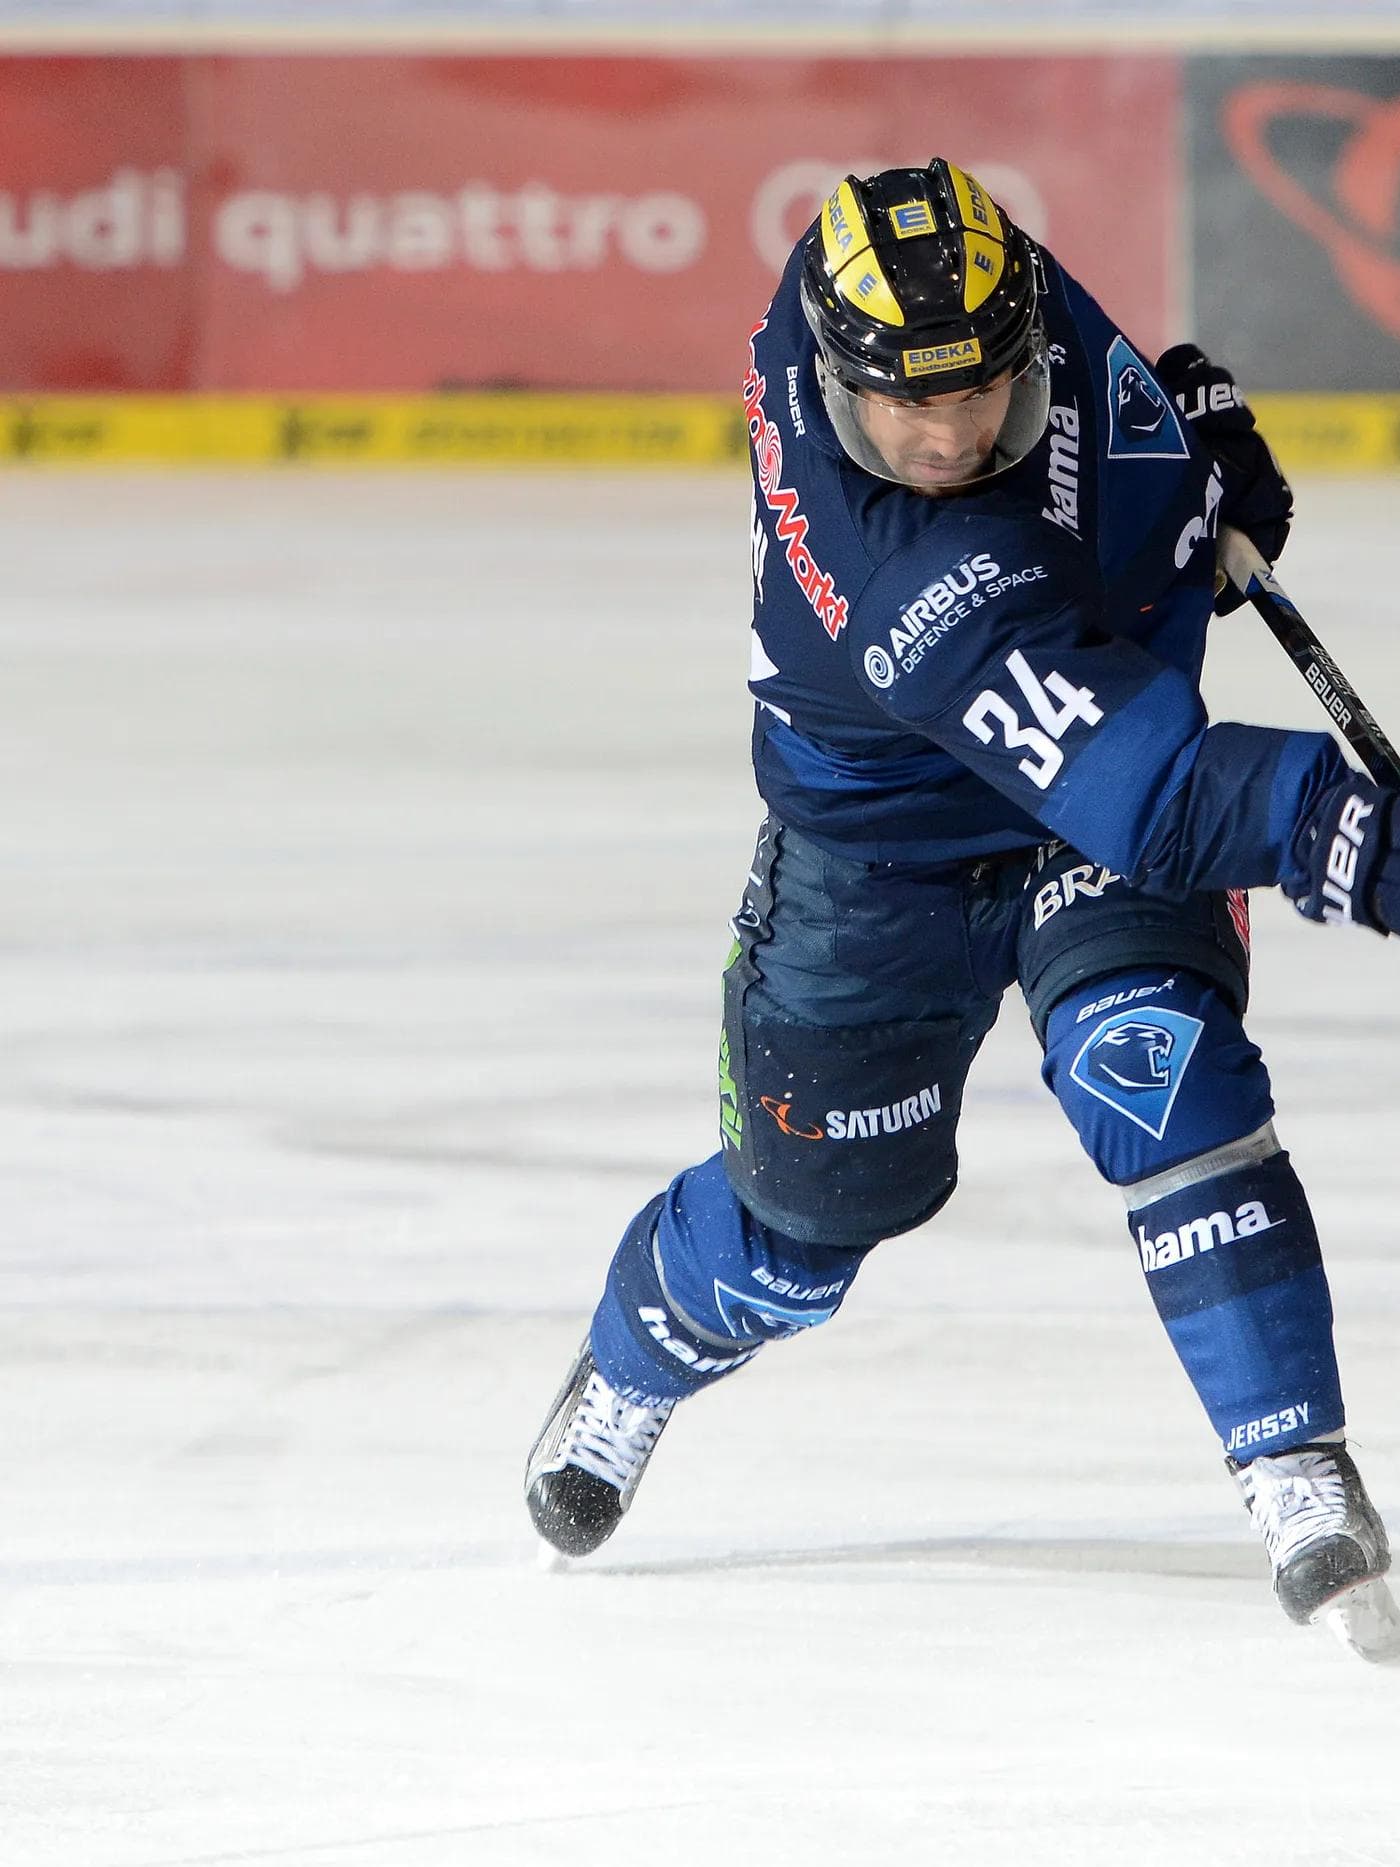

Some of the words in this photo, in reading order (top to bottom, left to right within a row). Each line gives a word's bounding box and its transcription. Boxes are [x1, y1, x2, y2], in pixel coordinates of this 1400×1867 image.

[212, 188, 706, 293] quattro
[895, 205, 930, 229] E
[908, 341, 975, 364] EDEKA
[786, 365, 806, 439] BAUER
[1041, 394, 1082, 541] hama
[766, 487, 849, 642] Markt
[889, 552, 1001, 660] AIRBUS
[901, 600, 972, 674] DEFENCE
[971, 592, 987, 608] &
[985, 565, 1049, 599] SPACE
[961, 649, 1104, 790] 34
[1304, 661, 1353, 731] BAUER
[1076, 978, 1176, 1024] BAUER
[825, 1083, 942, 1140] SATURN
[1138, 1200, 1287, 1273] hama
[750, 1266, 844, 1301] BAUER
